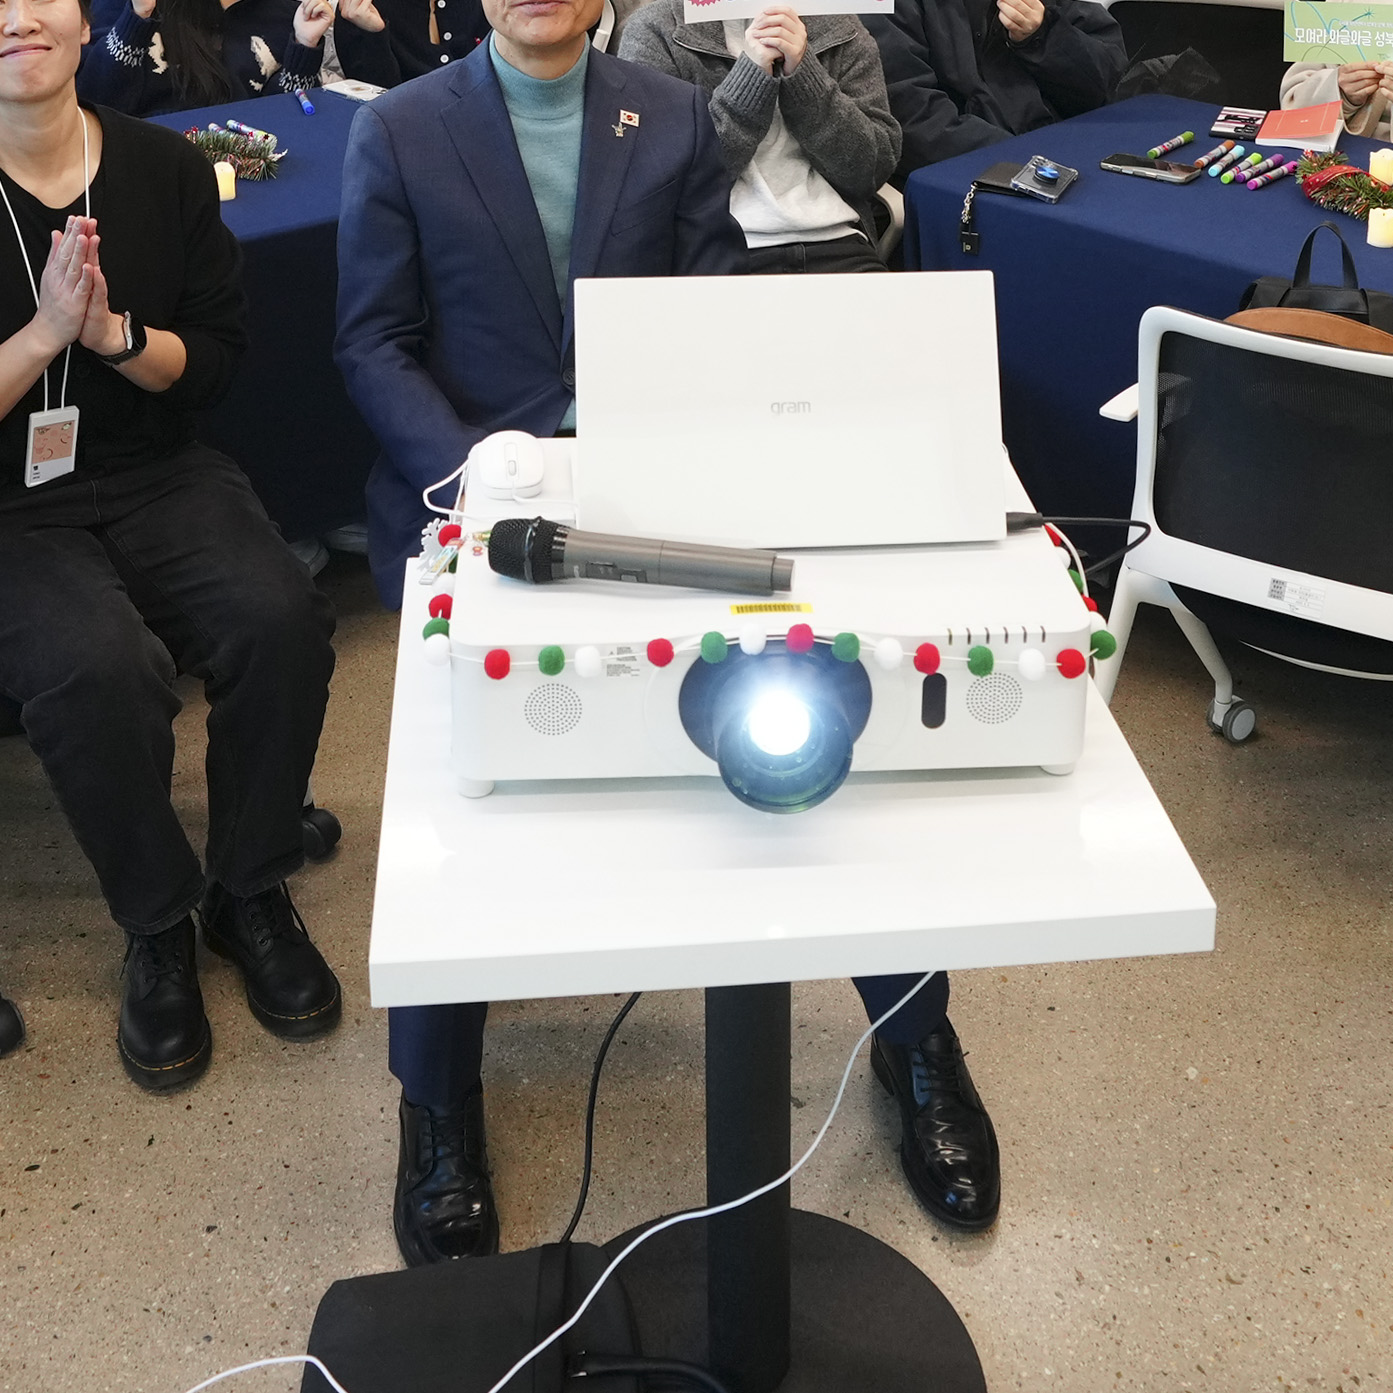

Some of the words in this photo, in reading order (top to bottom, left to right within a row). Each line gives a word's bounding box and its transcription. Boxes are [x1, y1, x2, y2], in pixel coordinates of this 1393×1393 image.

[1294, 27, 1327, 44] 모여라
[1329, 29, 1373, 47] 와글와글
[770, 401, 812, 416] gram
